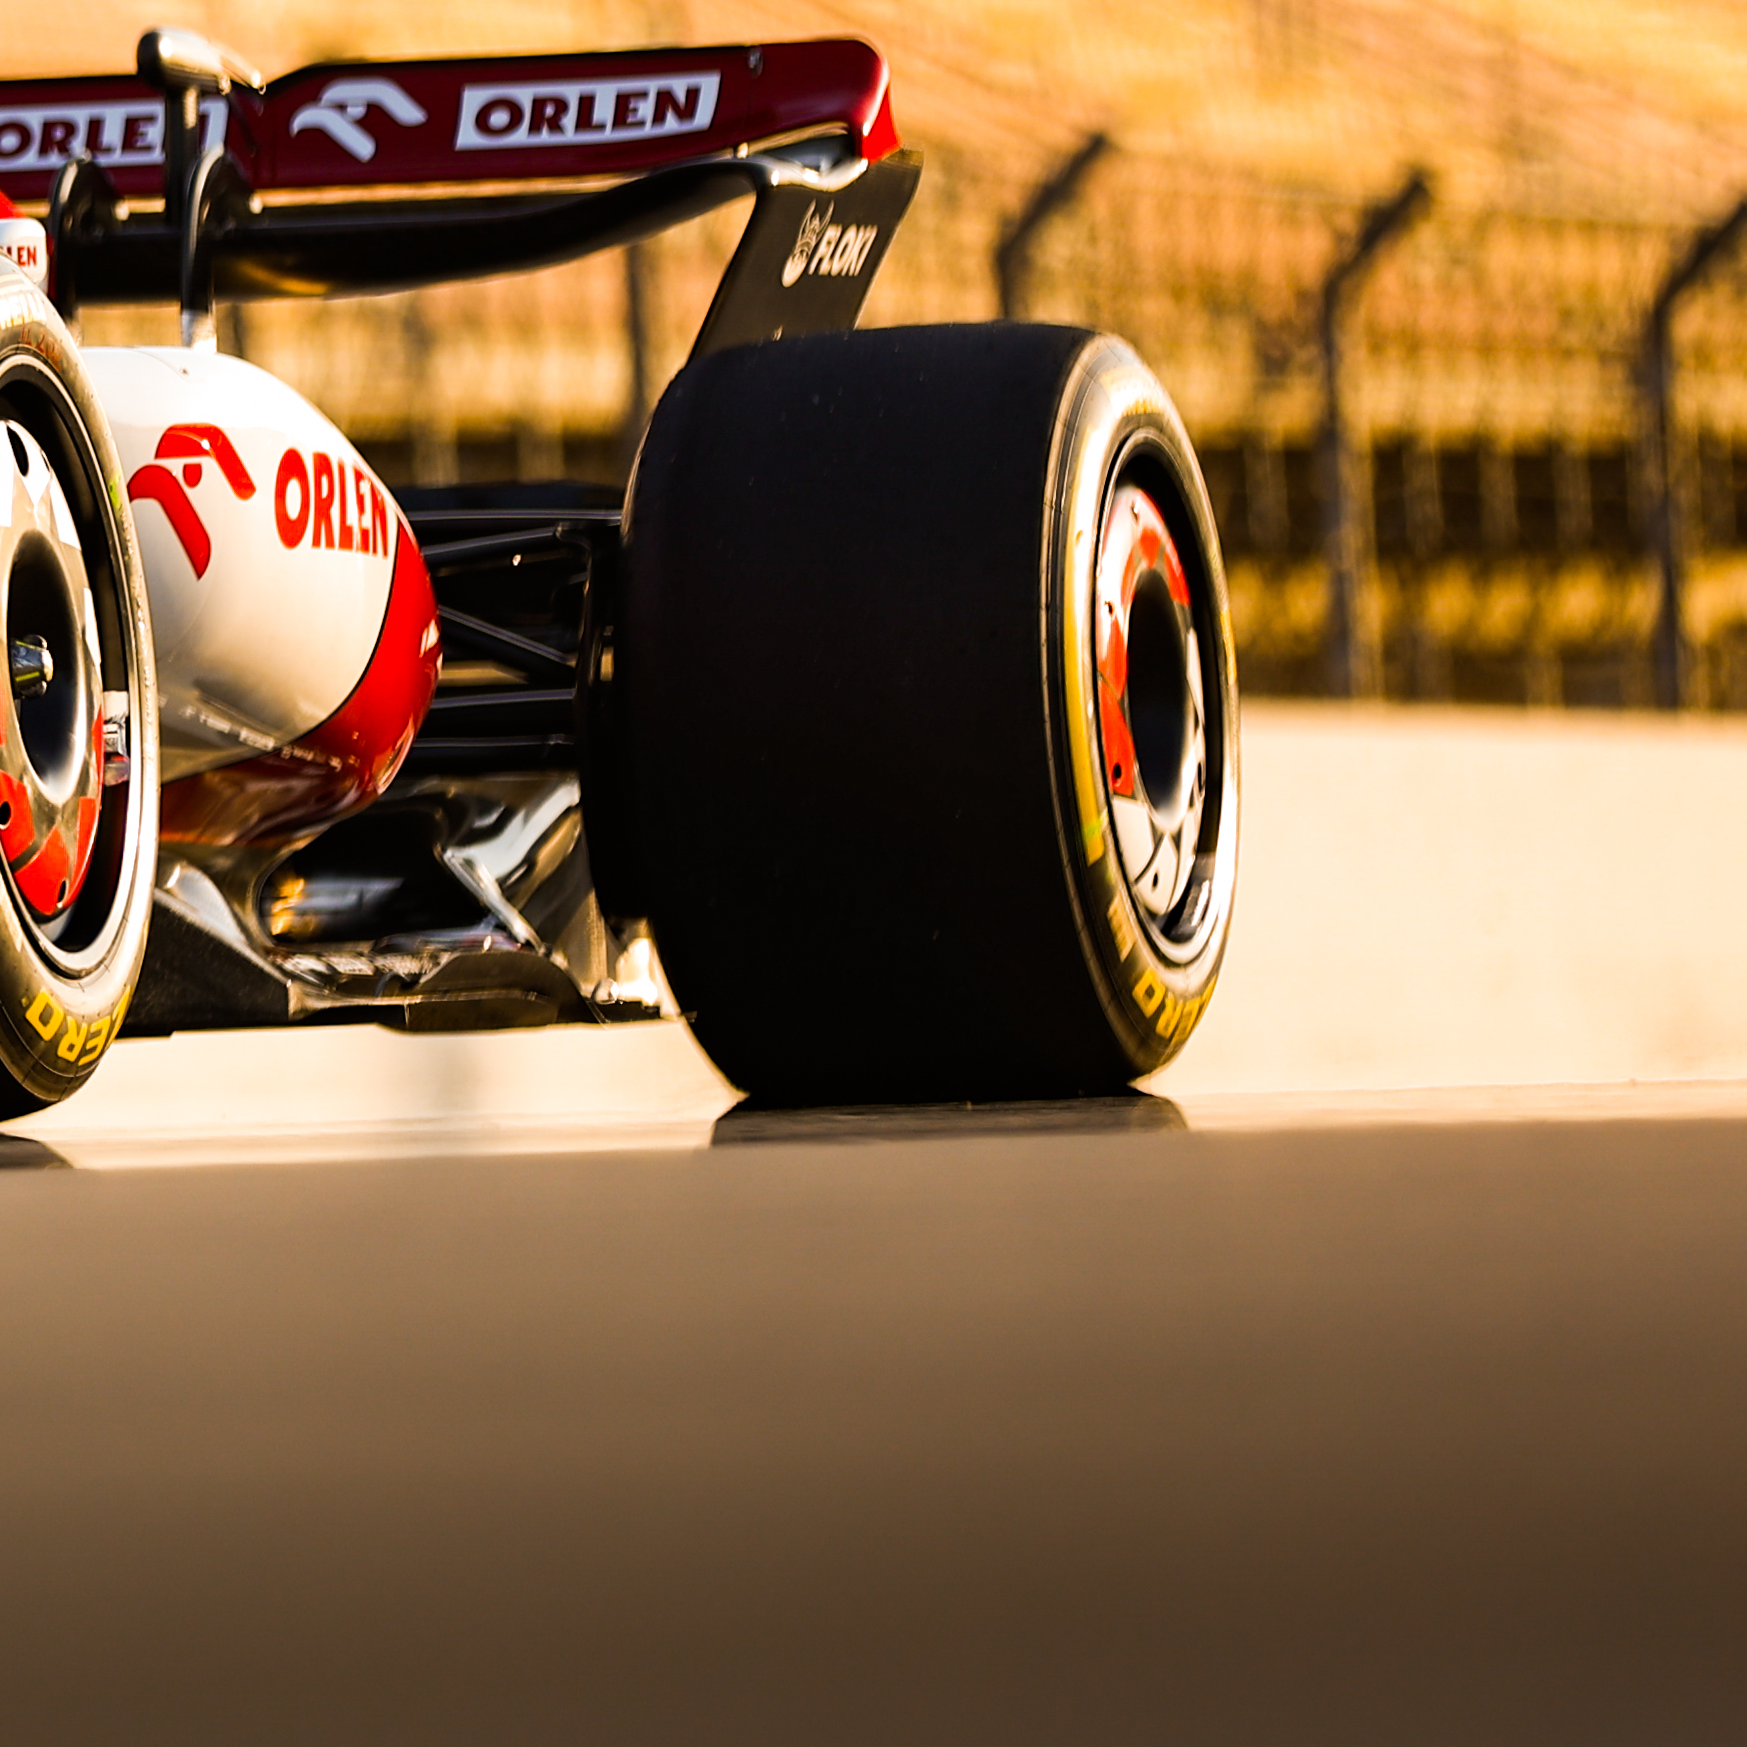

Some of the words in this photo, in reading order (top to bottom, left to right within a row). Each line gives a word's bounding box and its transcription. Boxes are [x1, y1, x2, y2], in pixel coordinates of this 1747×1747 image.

[473, 86, 702, 137] ORLEN
[808, 223, 878, 277] FLOKI
[273, 446, 389, 560] ORLEN
